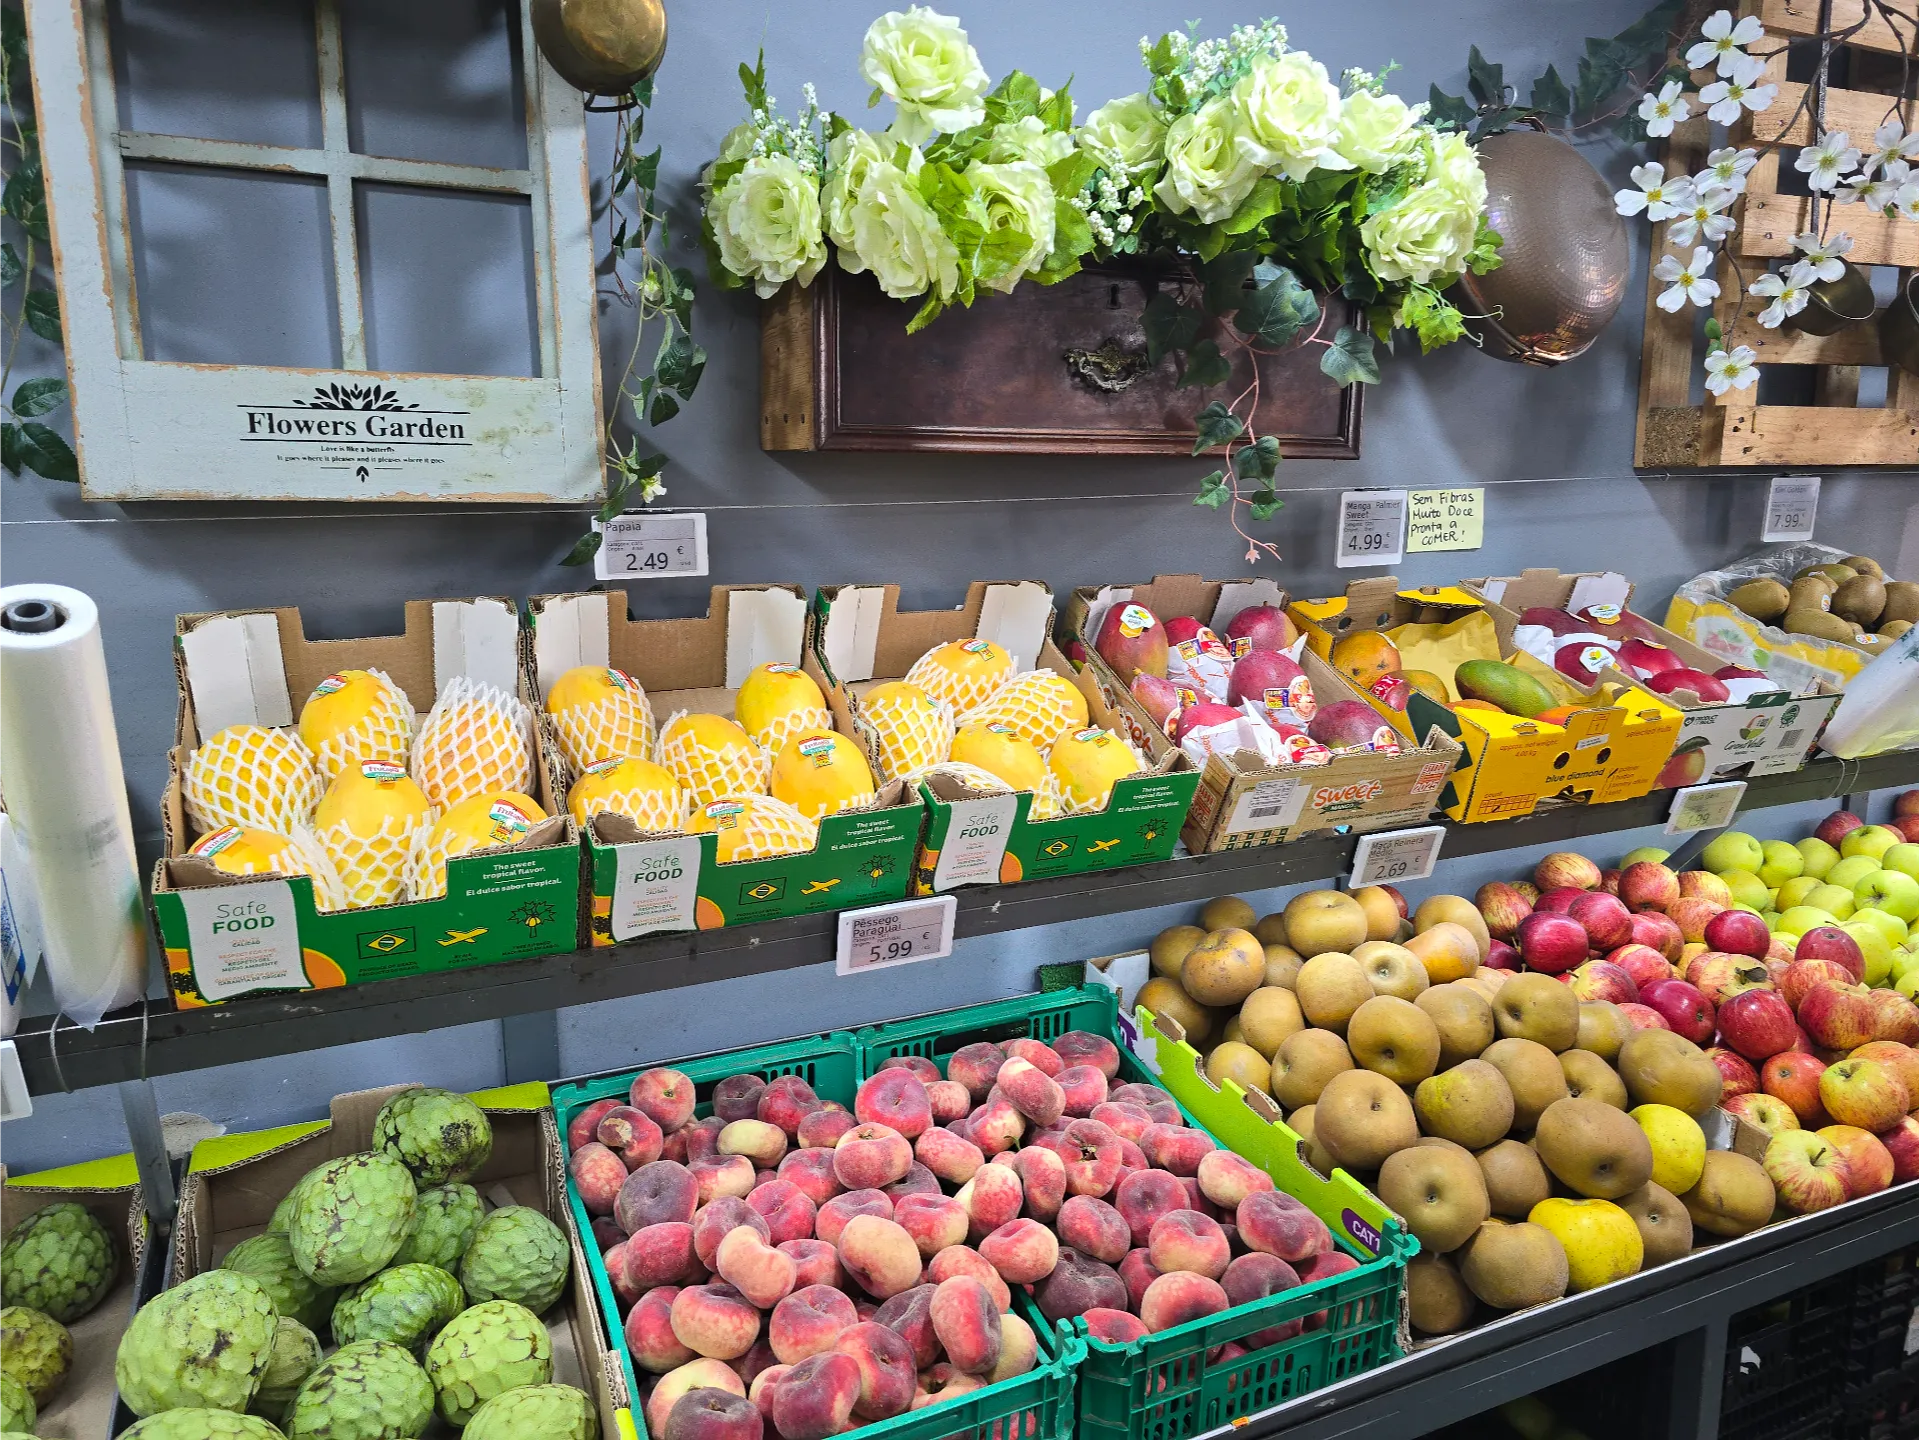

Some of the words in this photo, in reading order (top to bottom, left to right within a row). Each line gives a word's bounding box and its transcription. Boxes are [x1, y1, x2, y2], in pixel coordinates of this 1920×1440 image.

[246, 411, 357, 436] Flowers
[365, 415, 465, 439] Garden
[1347, 502, 1371, 511] Manga
[1376, 501, 1400, 509] Palmer
[1412, 493, 1433, 505] Sem
[1439, 491, 1474, 504] Fibras
[1346, 511, 1369, 519] Sweet
[1412, 507, 1441, 520] Muito
[1448, 504, 1474, 517] Doce
[605, 522, 641, 533] Papaia
[1449, 520, 1457, 529] a
[1774, 514, 1800, 528] 7.99
[1348, 533, 1382, 551] 4.99
[626, 552, 668, 571] 2.49
[1545, 774, 1565, 784] blue
[1567, 768, 1605, 781] diamond
[1314, 779, 1381, 807] Sweet
[966, 812, 998, 827] Safe
[1686, 812, 1710, 828] 1.99
[846, 828, 873, 836] tropical
[959, 825, 999, 839] FOOD
[509, 860, 536, 869] sweet
[639, 854, 680, 870] Safe
[482, 869, 517, 880] tropical
[518, 866, 546, 875] flavor.
[633, 868, 683, 883] FOOD
[1374, 861, 1407, 880] 2.69
[476, 886, 500, 895] dulce
[501, 882, 526, 892] sabor
[526, 877, 562, 888] tropical.
[216, 900, 267, 919] Safe
[212, 916, 275, 935] FOOD
[853, 915, 899, 929] Pêssego
[853, 922, 902, 938] Paraguai
[869, 940, 912, 963] 5.99
[922, 931, 930, 940] €
